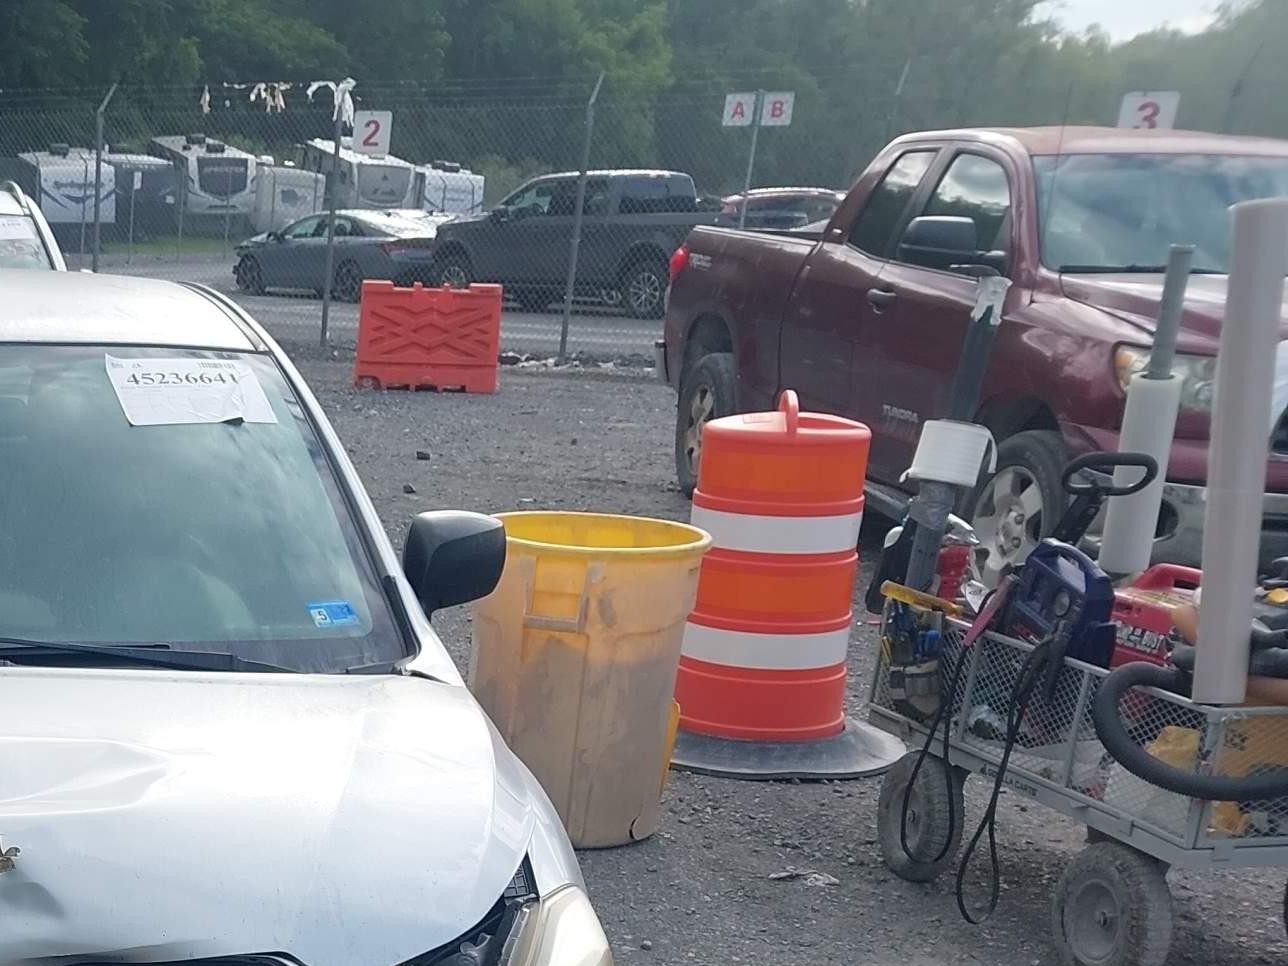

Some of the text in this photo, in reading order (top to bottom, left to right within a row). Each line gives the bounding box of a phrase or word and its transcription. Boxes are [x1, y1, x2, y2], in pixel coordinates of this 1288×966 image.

[731, 102, 745, 118] A
[771, 101, 785, 118] B
[1132, 101, 1161, 129] 3
[362, 120, 380, 147] 2
[126, 372, 240, 386] 45236641
